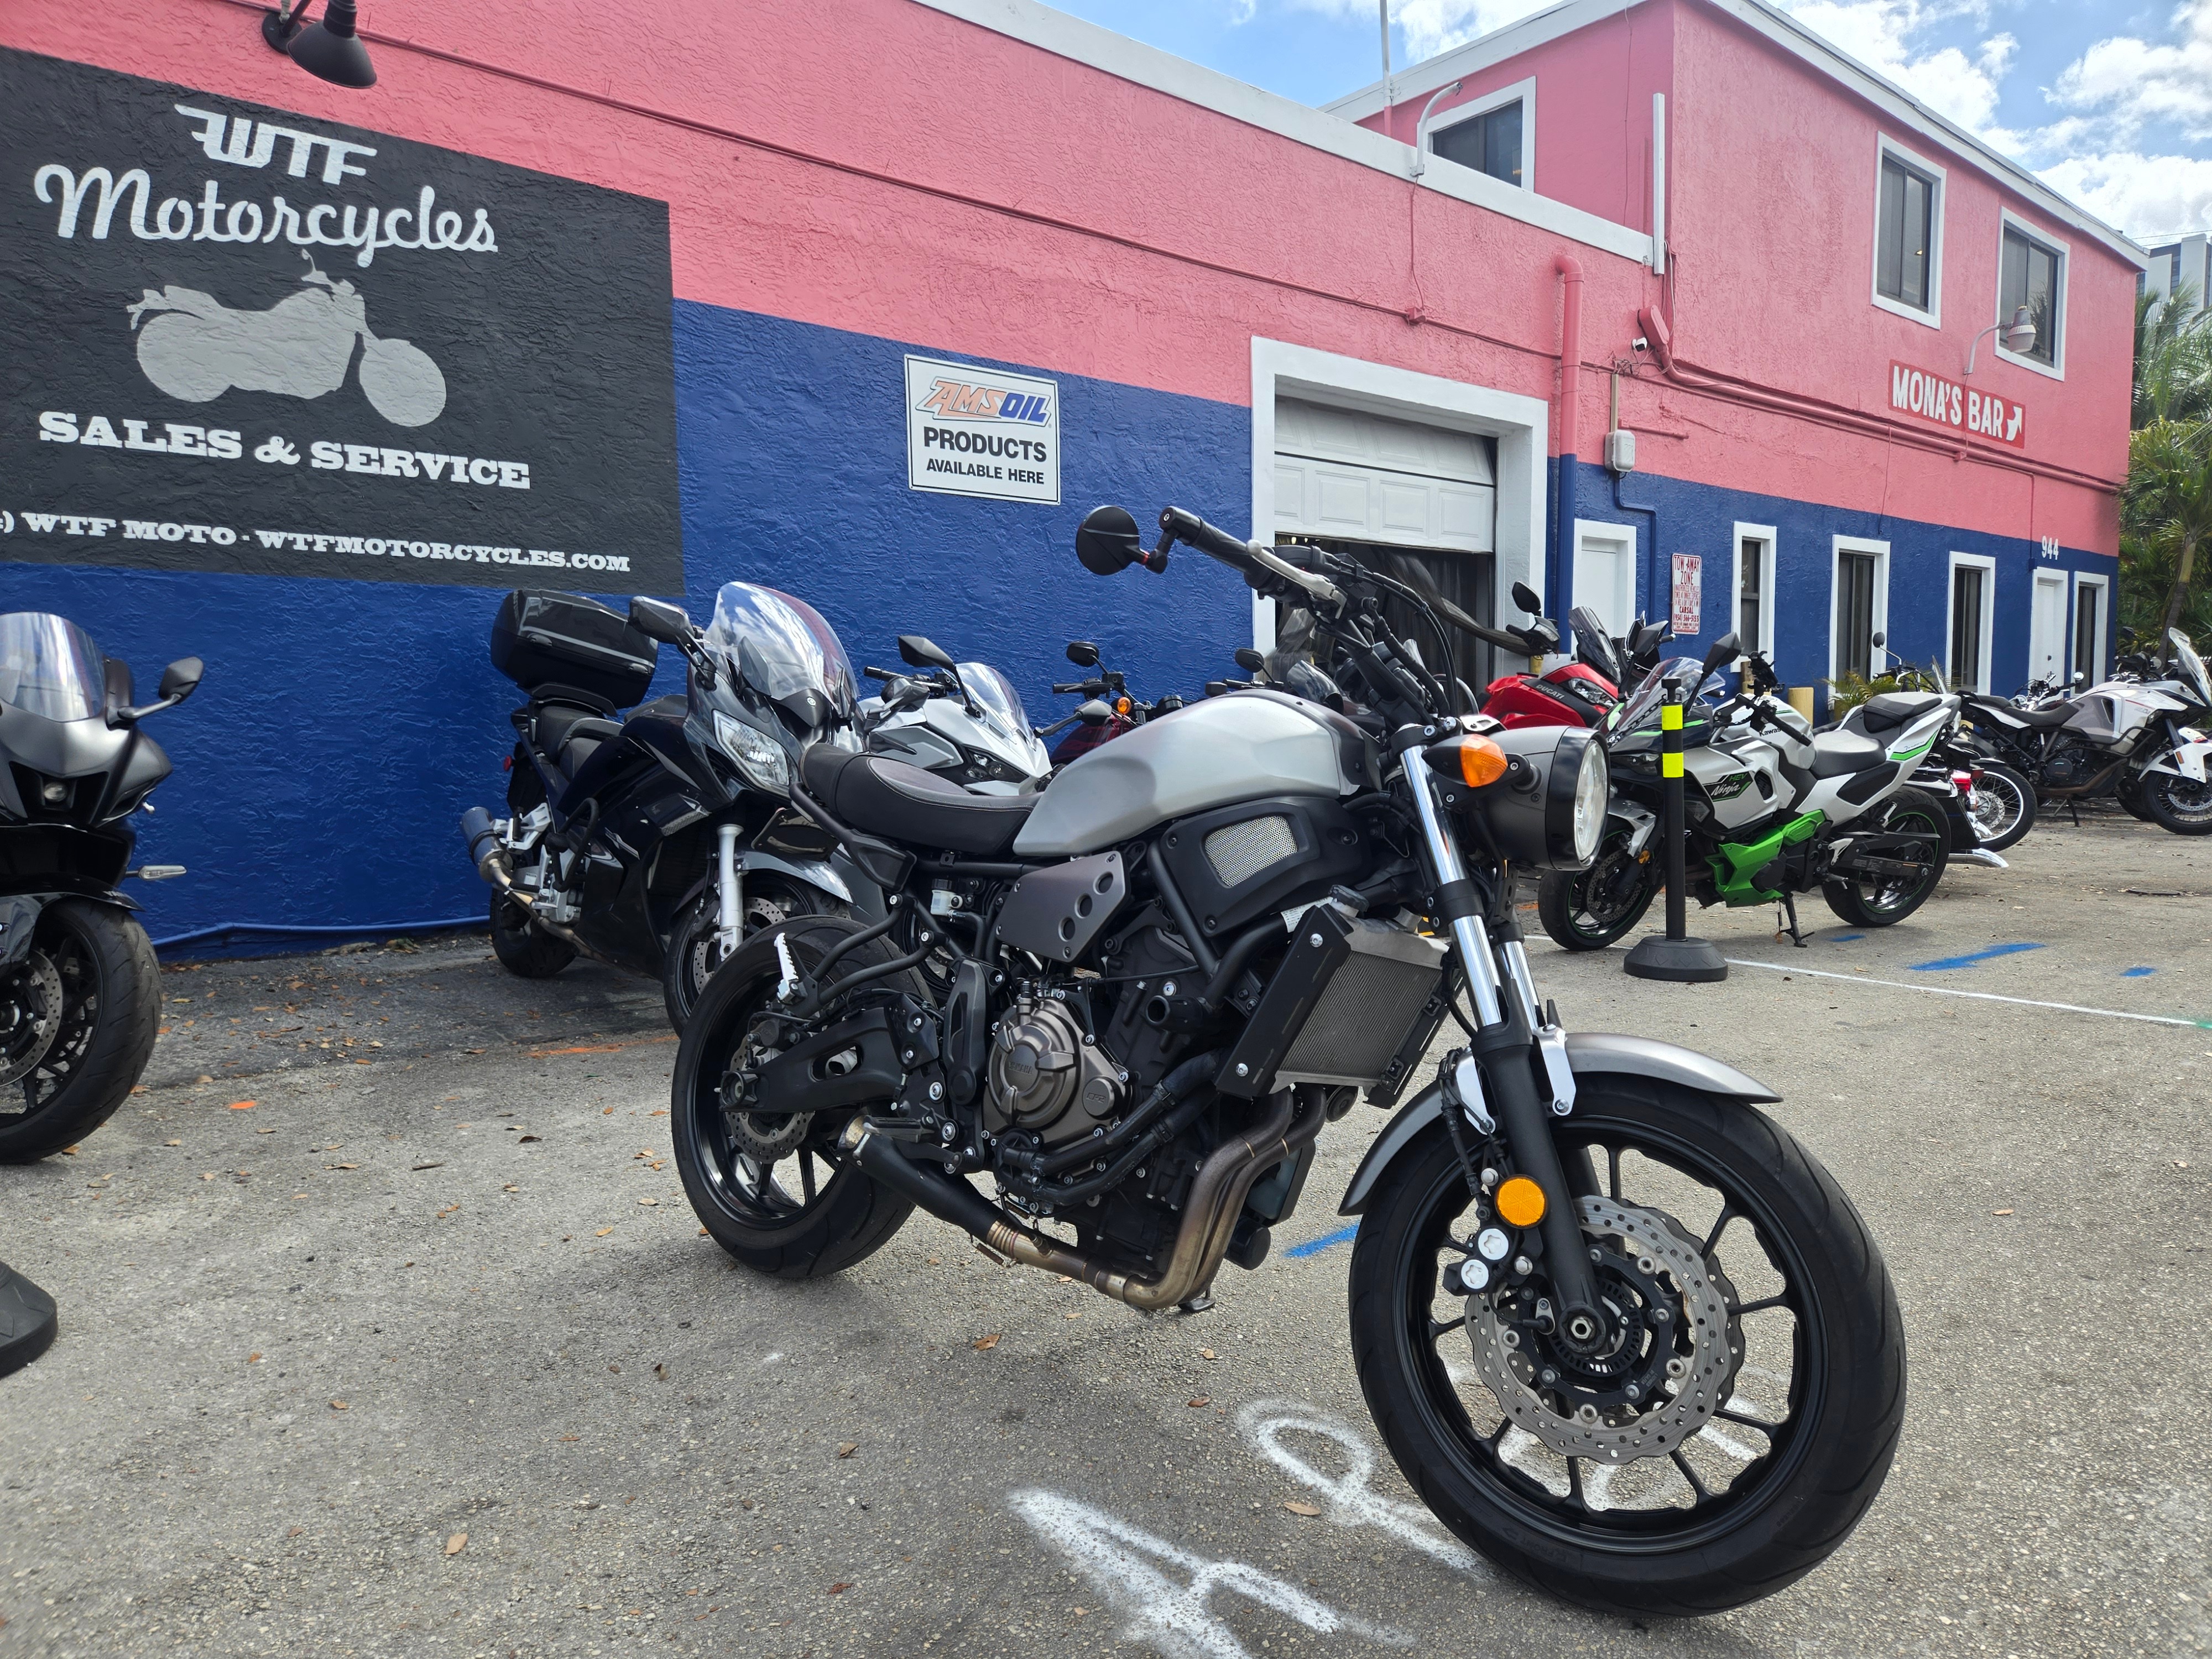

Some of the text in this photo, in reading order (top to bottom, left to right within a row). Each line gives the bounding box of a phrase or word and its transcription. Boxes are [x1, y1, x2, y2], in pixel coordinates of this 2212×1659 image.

[175, 104, 377, 185] WTF
[34, 164, 498, 267] Motorcycles
[924, 380, 1047, 423] AMSOIL
[1892, 366, 2004, 439] MONA'S BAR
[39, 411, 530, 489] SALES & SERVICE
[924, 426, 1047, 462] PRODUCTS
[926, 458, 1044, 484] AVAILABLE HERE
[21, 513, 116, 536] WTF
[122, 520, 236, 545] MOTO
[255, 530, 630, 572] WTFMOTORCYCLES.COM
[2042, 535, 2059, 560] 944
[1681, 570, 1693, 585] ZONE
[1536, 684, 1564, 699] DUCATI
[1710, 782, 1741, 797] Ninja
[1729, 773, 1748, 781] HEV
